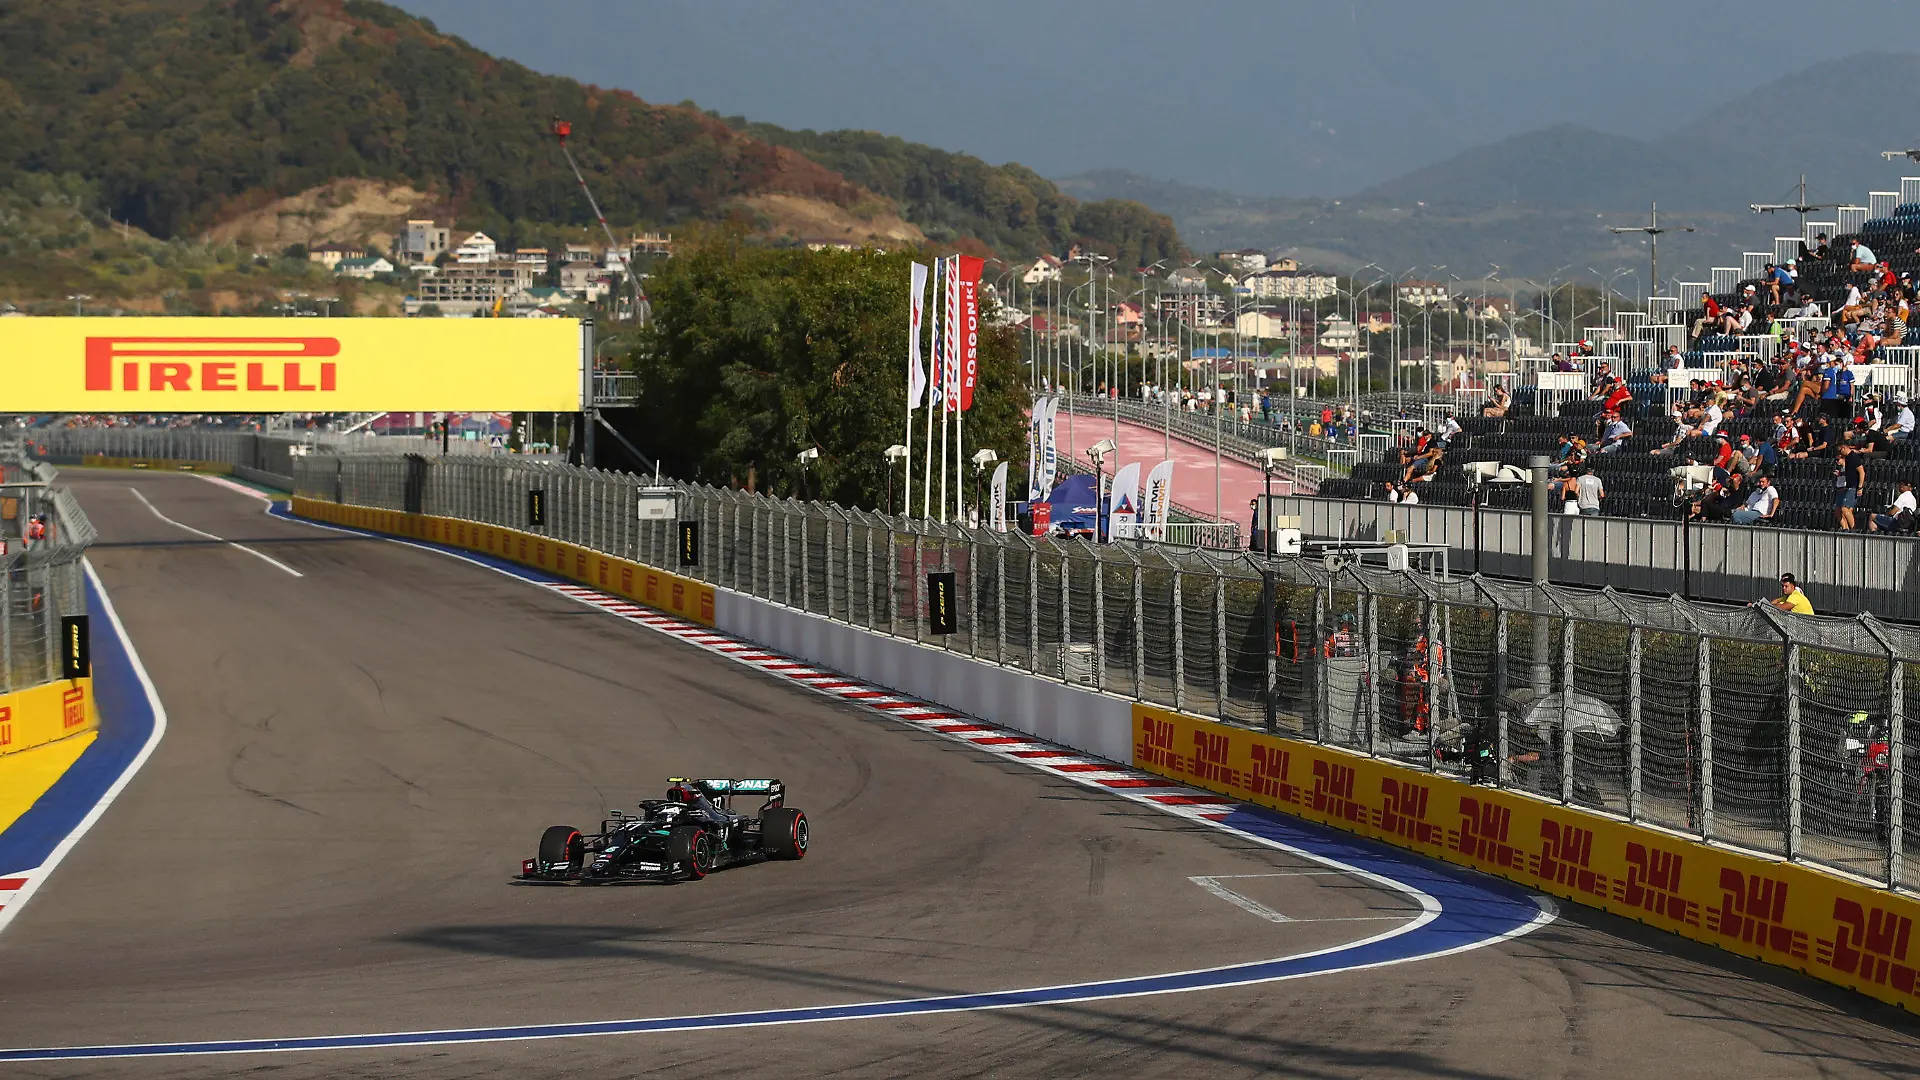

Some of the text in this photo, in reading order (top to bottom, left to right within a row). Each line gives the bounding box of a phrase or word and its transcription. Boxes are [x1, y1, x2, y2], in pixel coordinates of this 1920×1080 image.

[85, 336, 339, 392] PIRELLI
[938, 581, 946, 616] ZERO
[71, 624, 80, 659] ZERO
[63, 686, 84, 729] PIRELLI
[1143, 716, 1177, 768] DHL
[1193, 729, 1233, 785] DHL
[706, 779, 770, 791] PETONAS
[1251, 743, 1294, 801] DHL
[1312, 759, 1358, 822] DHL
[713, 796, 722, 809] 77
[1382, 777, 1434, 843] DHL
[1459, 796, 1514, 868] DHL
[1540, 818, 1596, 893] DHL
[1625, 841, 1686, 922] DHL
[1719, 867, 1793, 954] DHL
[1832, 896, 1917, 995] DHL
